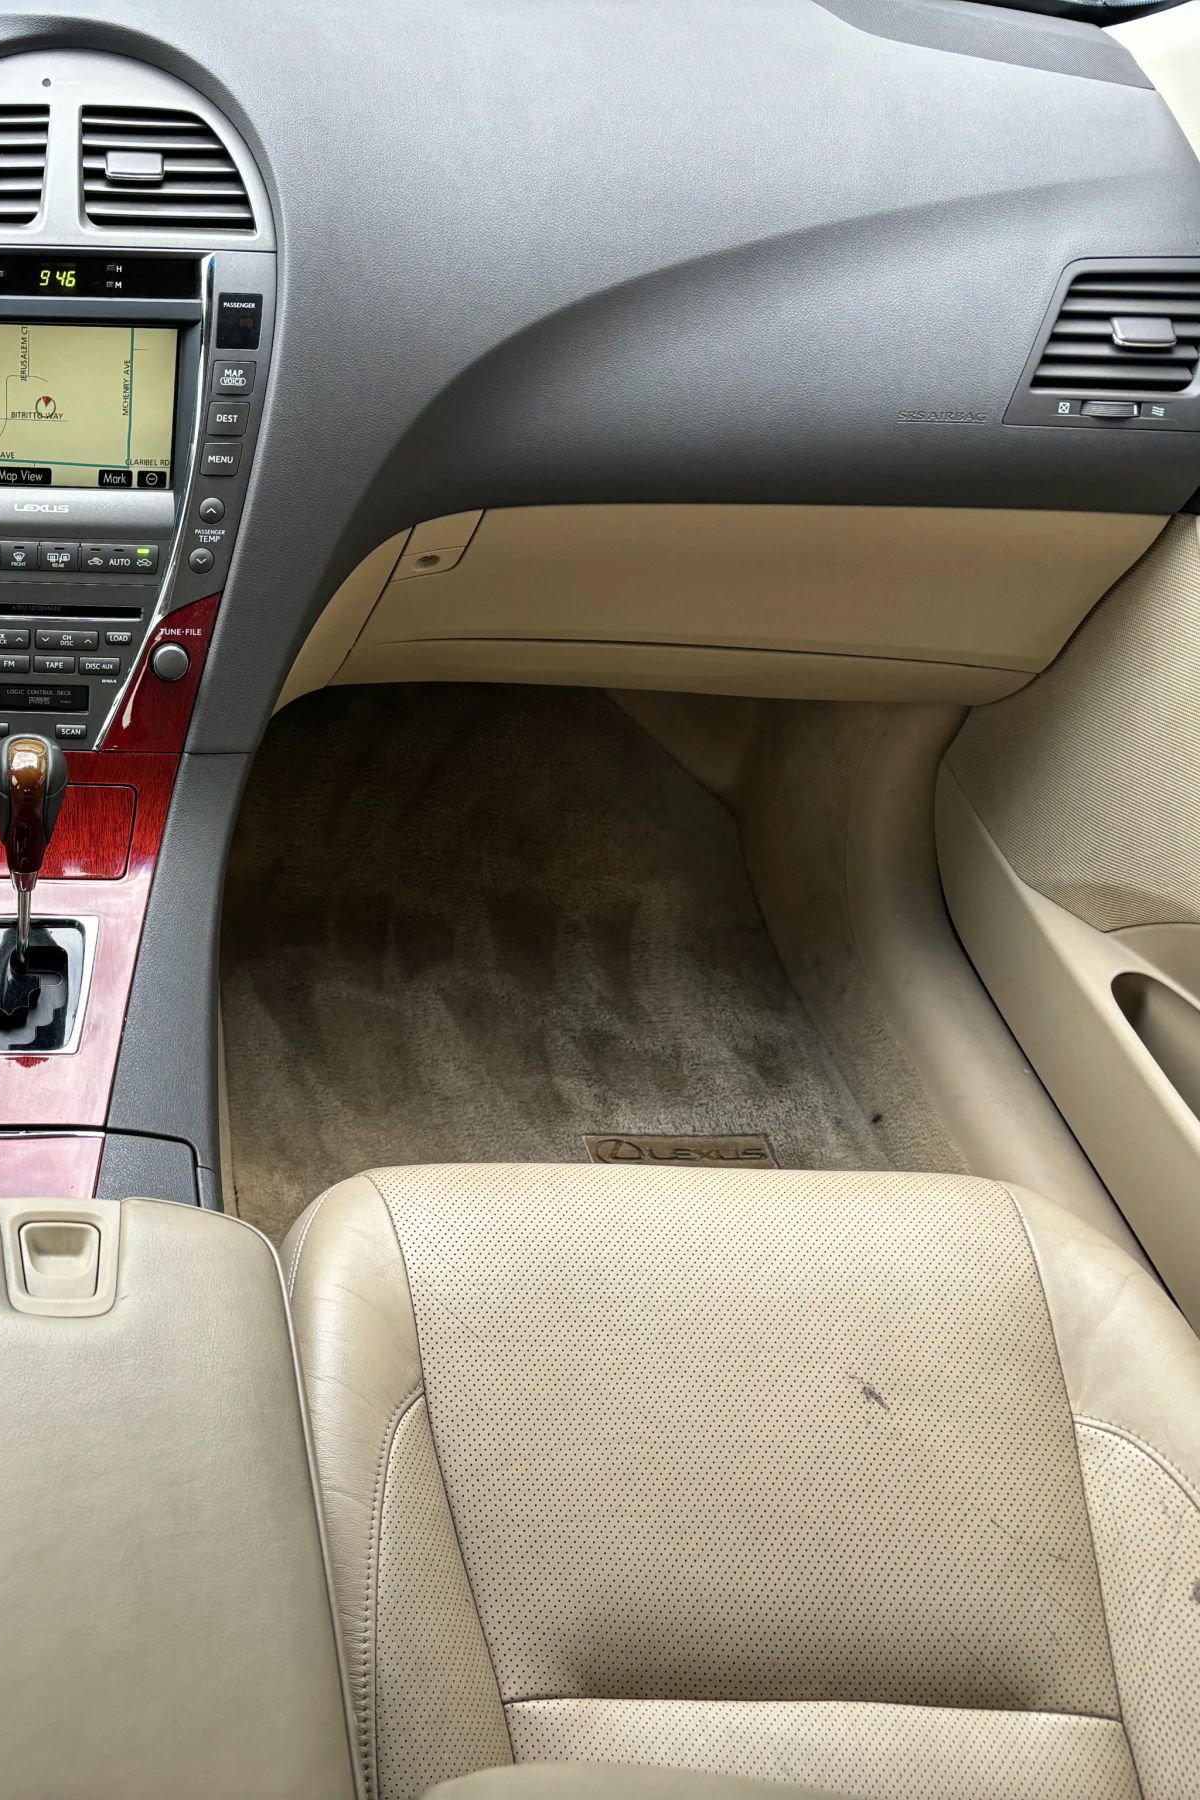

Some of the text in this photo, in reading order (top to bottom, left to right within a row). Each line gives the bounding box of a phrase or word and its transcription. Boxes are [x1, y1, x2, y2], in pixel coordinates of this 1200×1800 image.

[116, 265, 122, 273] H
[22, 326, 28, 334] CT
[224, 369, 244, 377] MAP
[11, 412, 64, 420] BITRITTO WAY
[216, 414, 238, 423] DEST
[160, 459, 170, 467] RD
[208, 456, 234, 464] MENU
[21, 470, 43, 481] View
[103, 472, 127, 484] Mark
[14, 503, 70, 513] LEXUS
[199, 535, 221, 543] TEMP
[108, 558, 130, 566] AUTO
[650, 1148, 768, 1161] LEXUS
